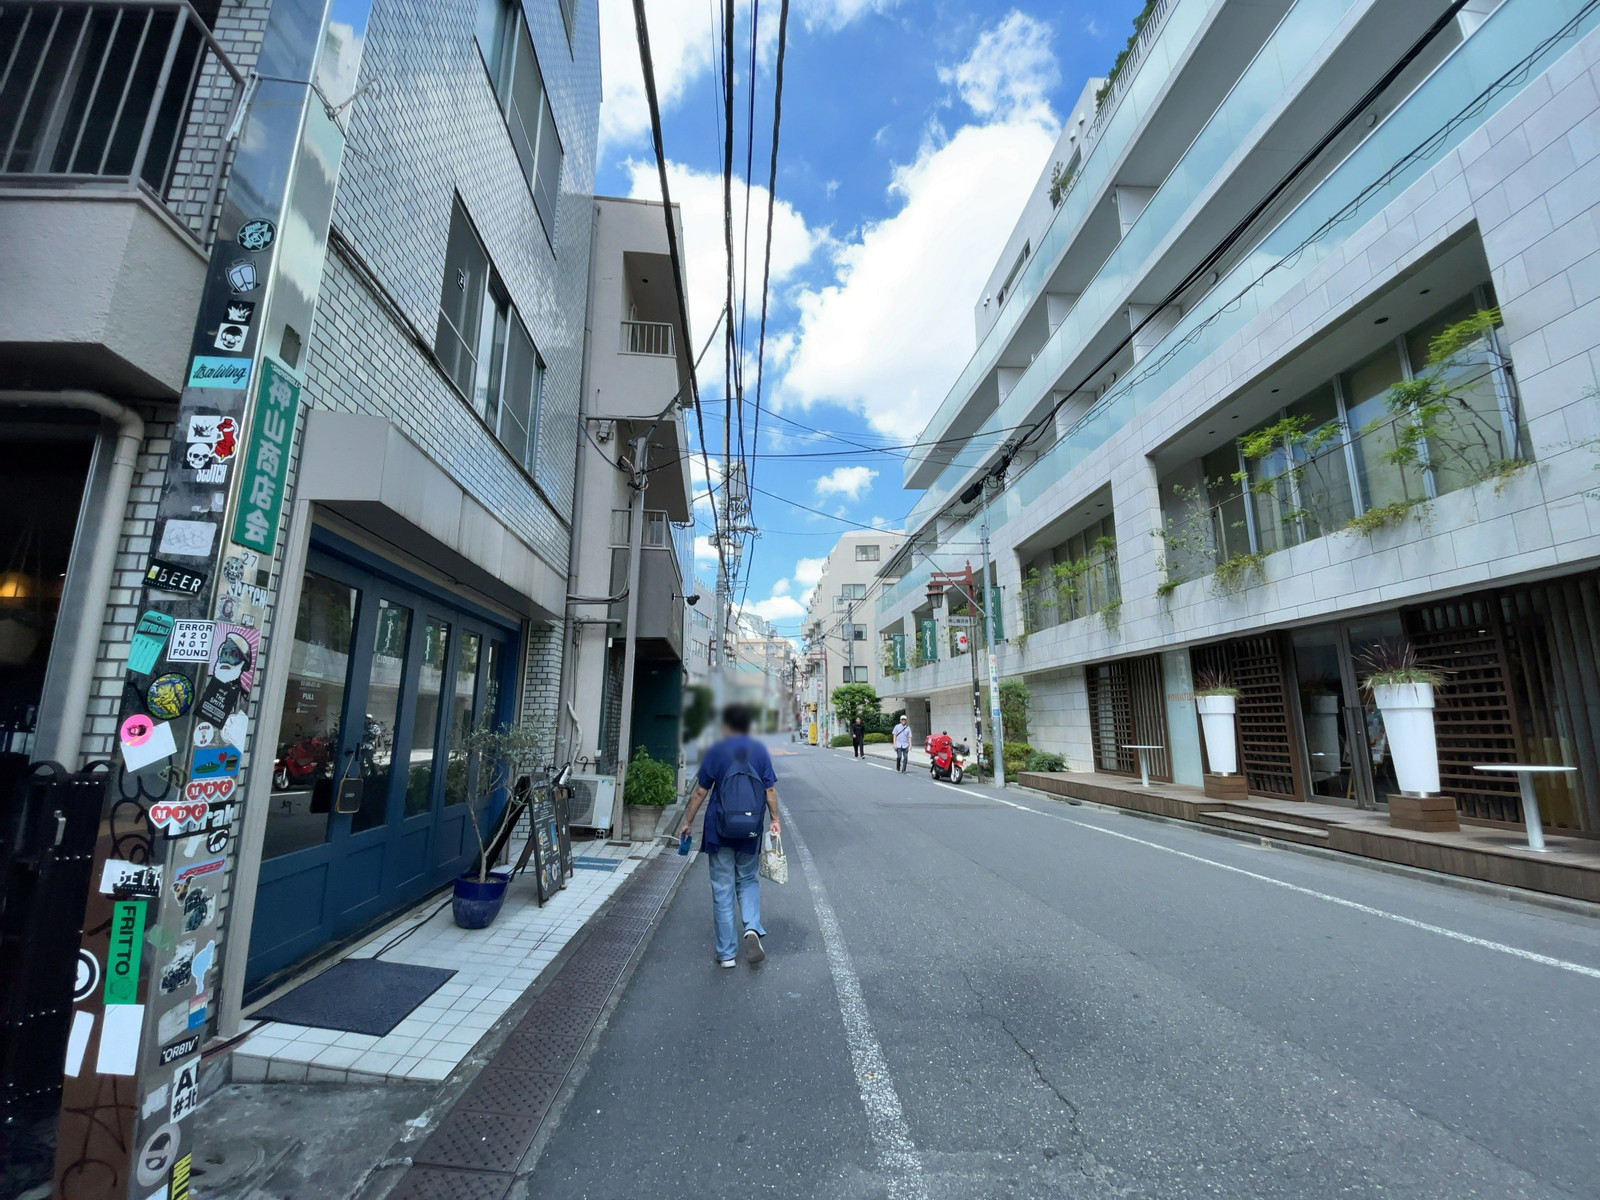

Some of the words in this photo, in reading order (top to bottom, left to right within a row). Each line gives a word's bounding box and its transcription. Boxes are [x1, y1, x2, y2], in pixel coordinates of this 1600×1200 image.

[244, 374, 293, 546] 神山商店会
[241, 552, 258, 568] 27
[158, 568, 202, 593] BEER
[178, 623, 213, 632] ERROR
[177, 640, 207, 649] NOT
[172, 648, 208, 657] FOUND
[209, 696, 226, 710] SMITH
[215, 692, 226, 703] THE
[115, 905, 137, 976] FRITTO
